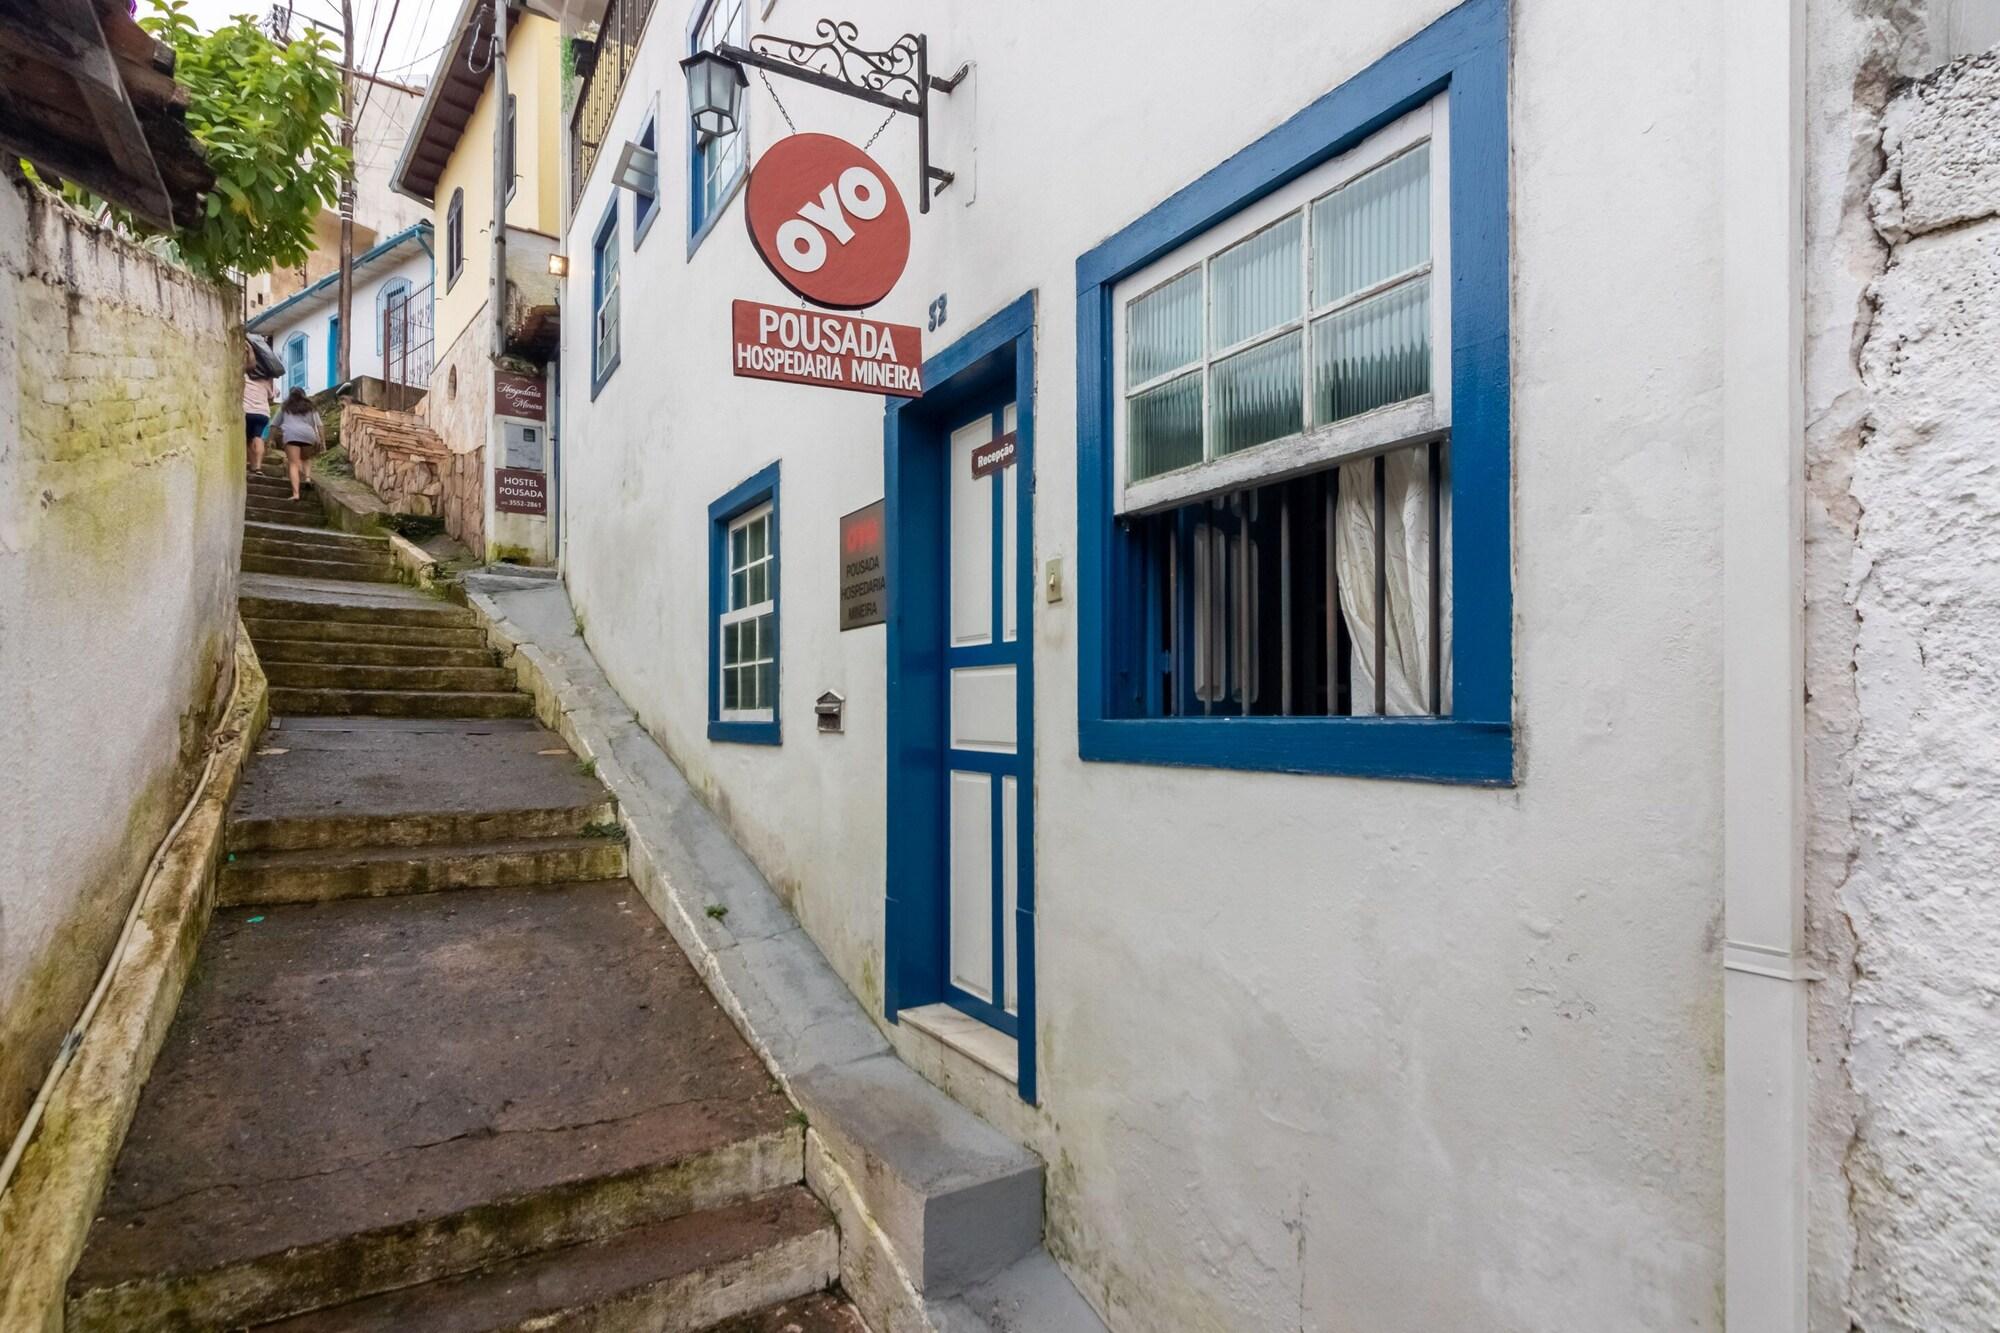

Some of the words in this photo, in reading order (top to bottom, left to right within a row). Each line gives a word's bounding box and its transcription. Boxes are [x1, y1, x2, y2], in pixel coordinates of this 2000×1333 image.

[776, 166, 887, 273] OYO
[759, 308, 897, 363] POUSADA
[737, 342, 843, 382] HOSPEDARIA
[851, 359, 922, 392] MINEIRA
[977, 442, 1014, 468] Recepção
[499, 486, 544, 498] POUSADA
[504, 476, 539, 488] HOSTEL
[846, 556, 880, 578] POUSADA
[840, 575, 886, 601] HOSPEDARIA
[848, 602, 878, 620] MINEIRA
